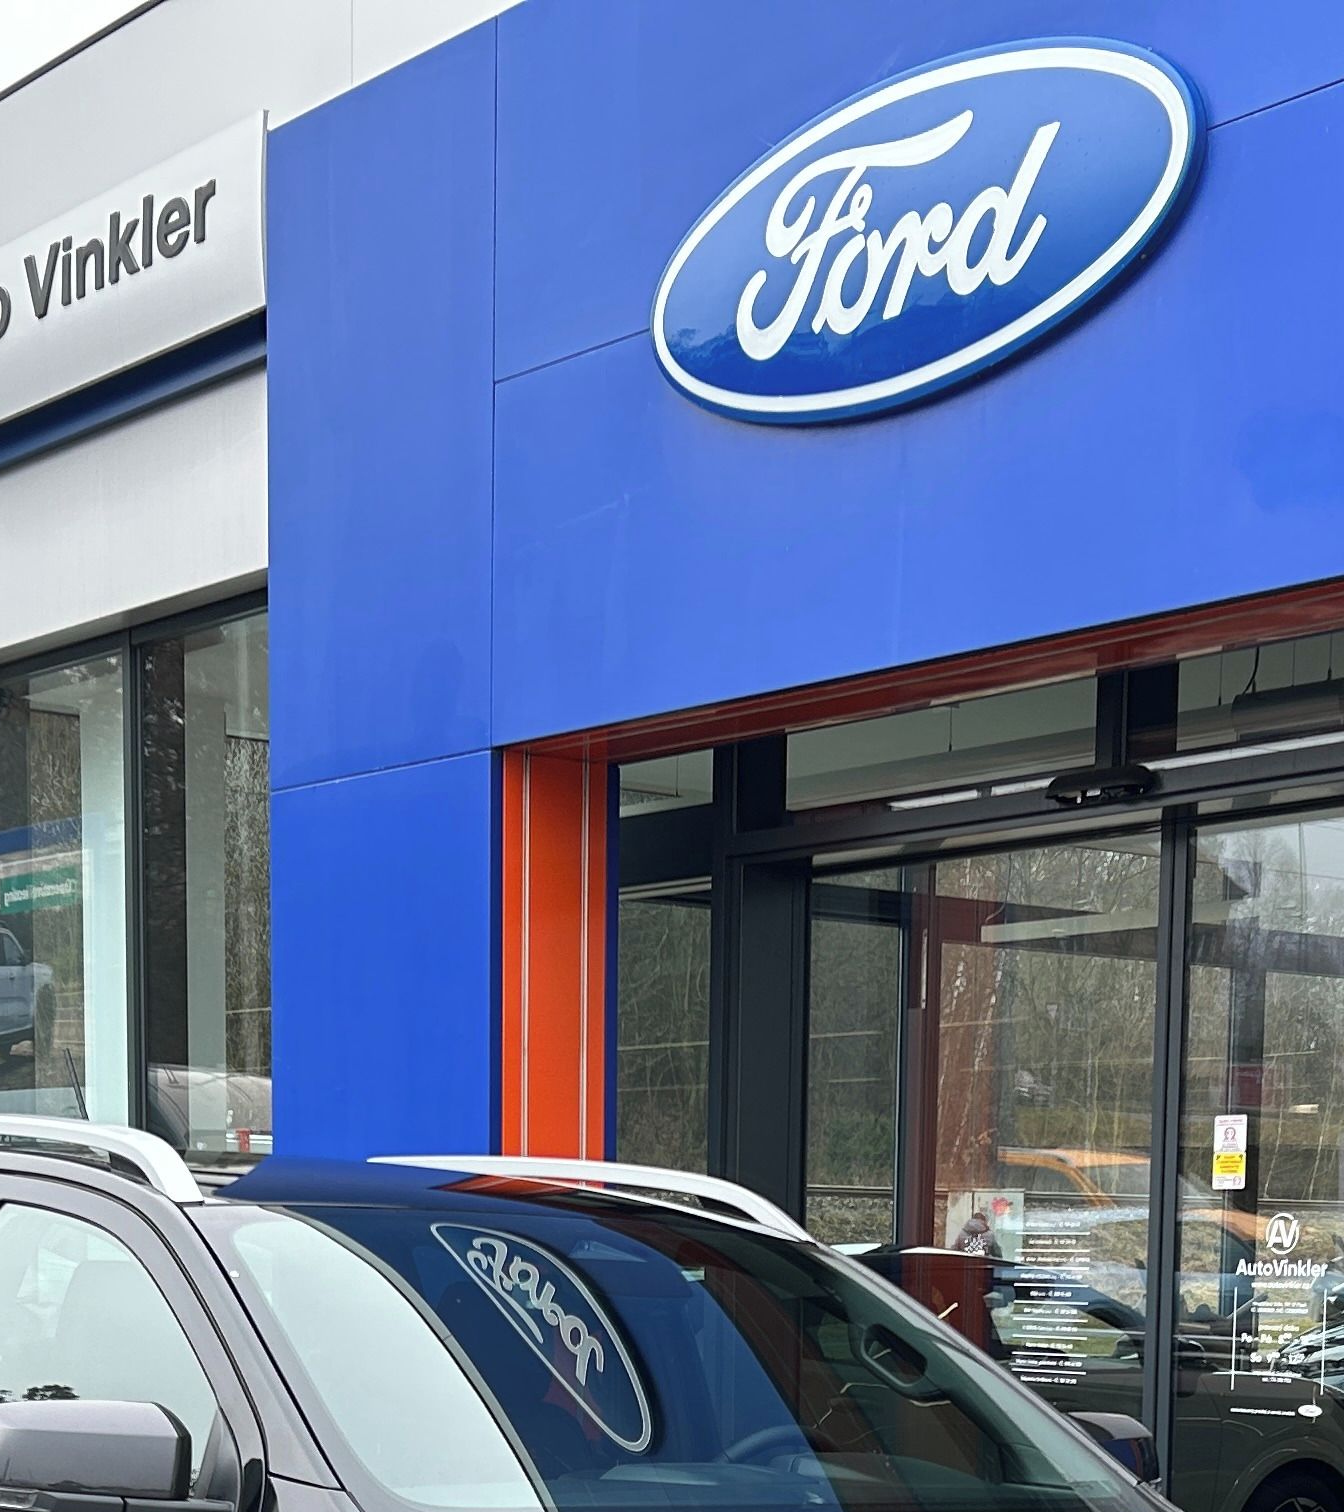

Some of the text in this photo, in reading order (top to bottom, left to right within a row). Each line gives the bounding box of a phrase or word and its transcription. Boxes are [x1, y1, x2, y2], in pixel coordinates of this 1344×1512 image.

[23, 178, 216, 319] Vinkler
[736, 109, 1061, 361] Ford
[1235, 1258, 1329, 1277] AutoVinkler
